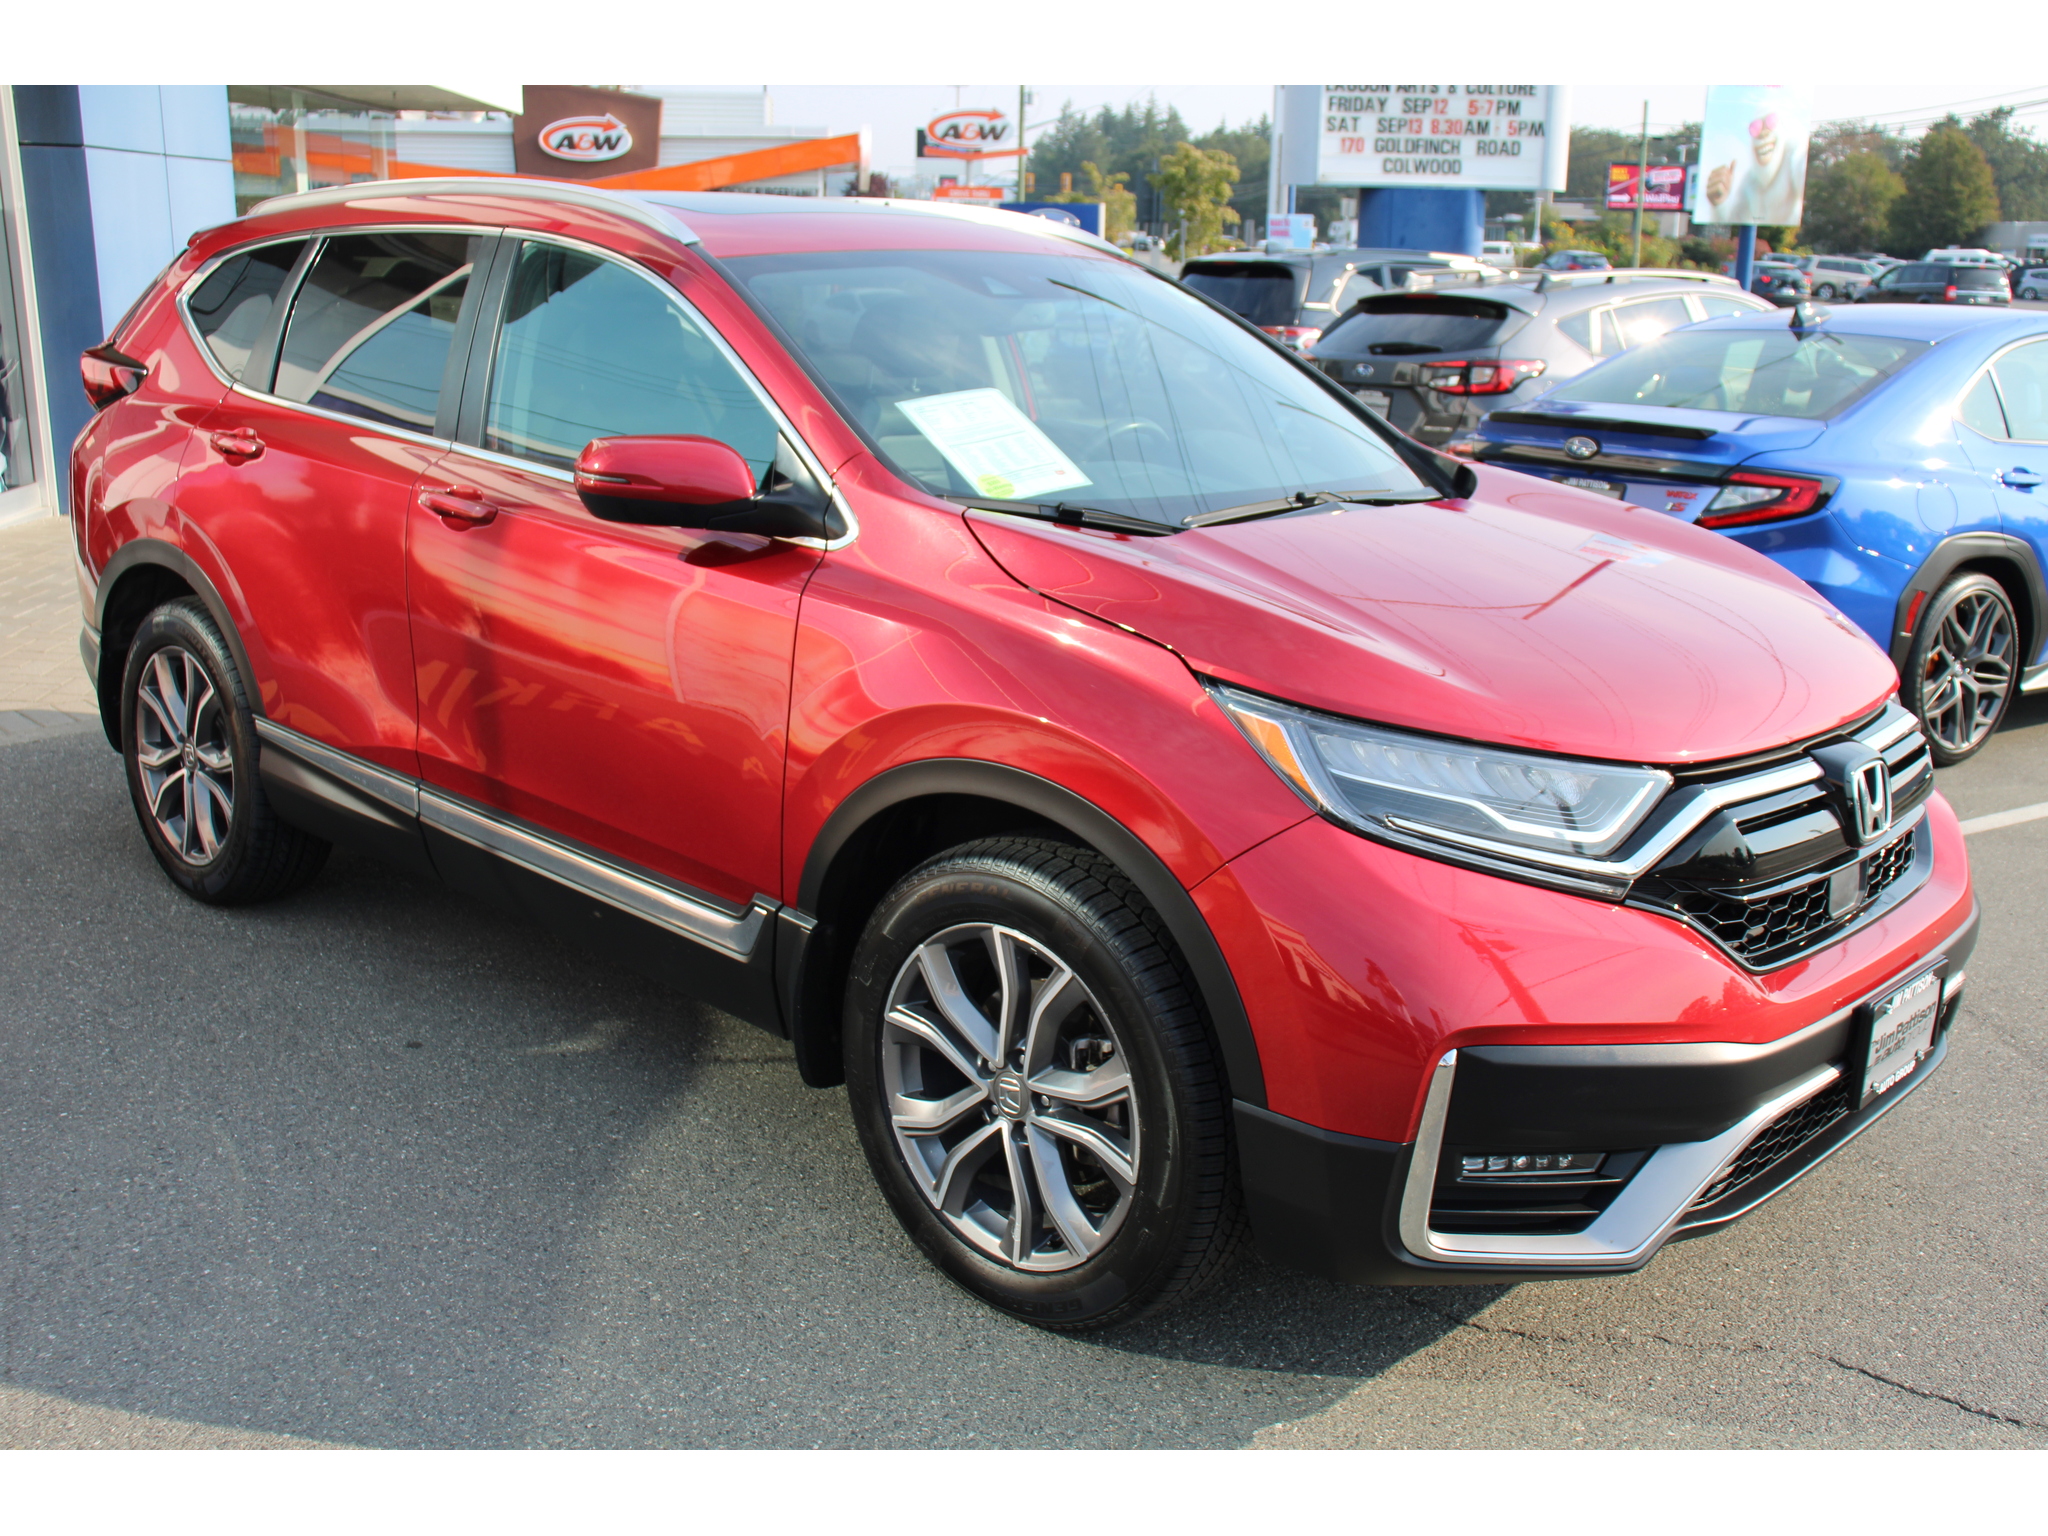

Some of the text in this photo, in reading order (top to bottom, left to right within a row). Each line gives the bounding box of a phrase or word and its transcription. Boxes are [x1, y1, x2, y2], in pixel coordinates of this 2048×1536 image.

[1396, 85, 1438, 93] ARTS
[1466, 85, 1536, 95] CULTURE
[1328, 96, 1388, 112] FRIDAY
[1403, 98, 1448, 114] SEP12
[941, 122, 1009, 140] A&W
[1327, 116, 1360, 132] SAT
[1377, 117, 1422, 134] SEP13
[1508, 120, 1545, 136] 5PM
[553, 132, 624, 150] A&W
[1341, 137, 1521, 156] 170 GOLDFINCH ROAD
[1383, 157, 1462, 175] COLWOOD
[1665, 489, 1699, 500] WRX
[1902, 970, 1934, 1004] PATTISON
[1880, 1060, 1916, 1094] AUTO GROUP
